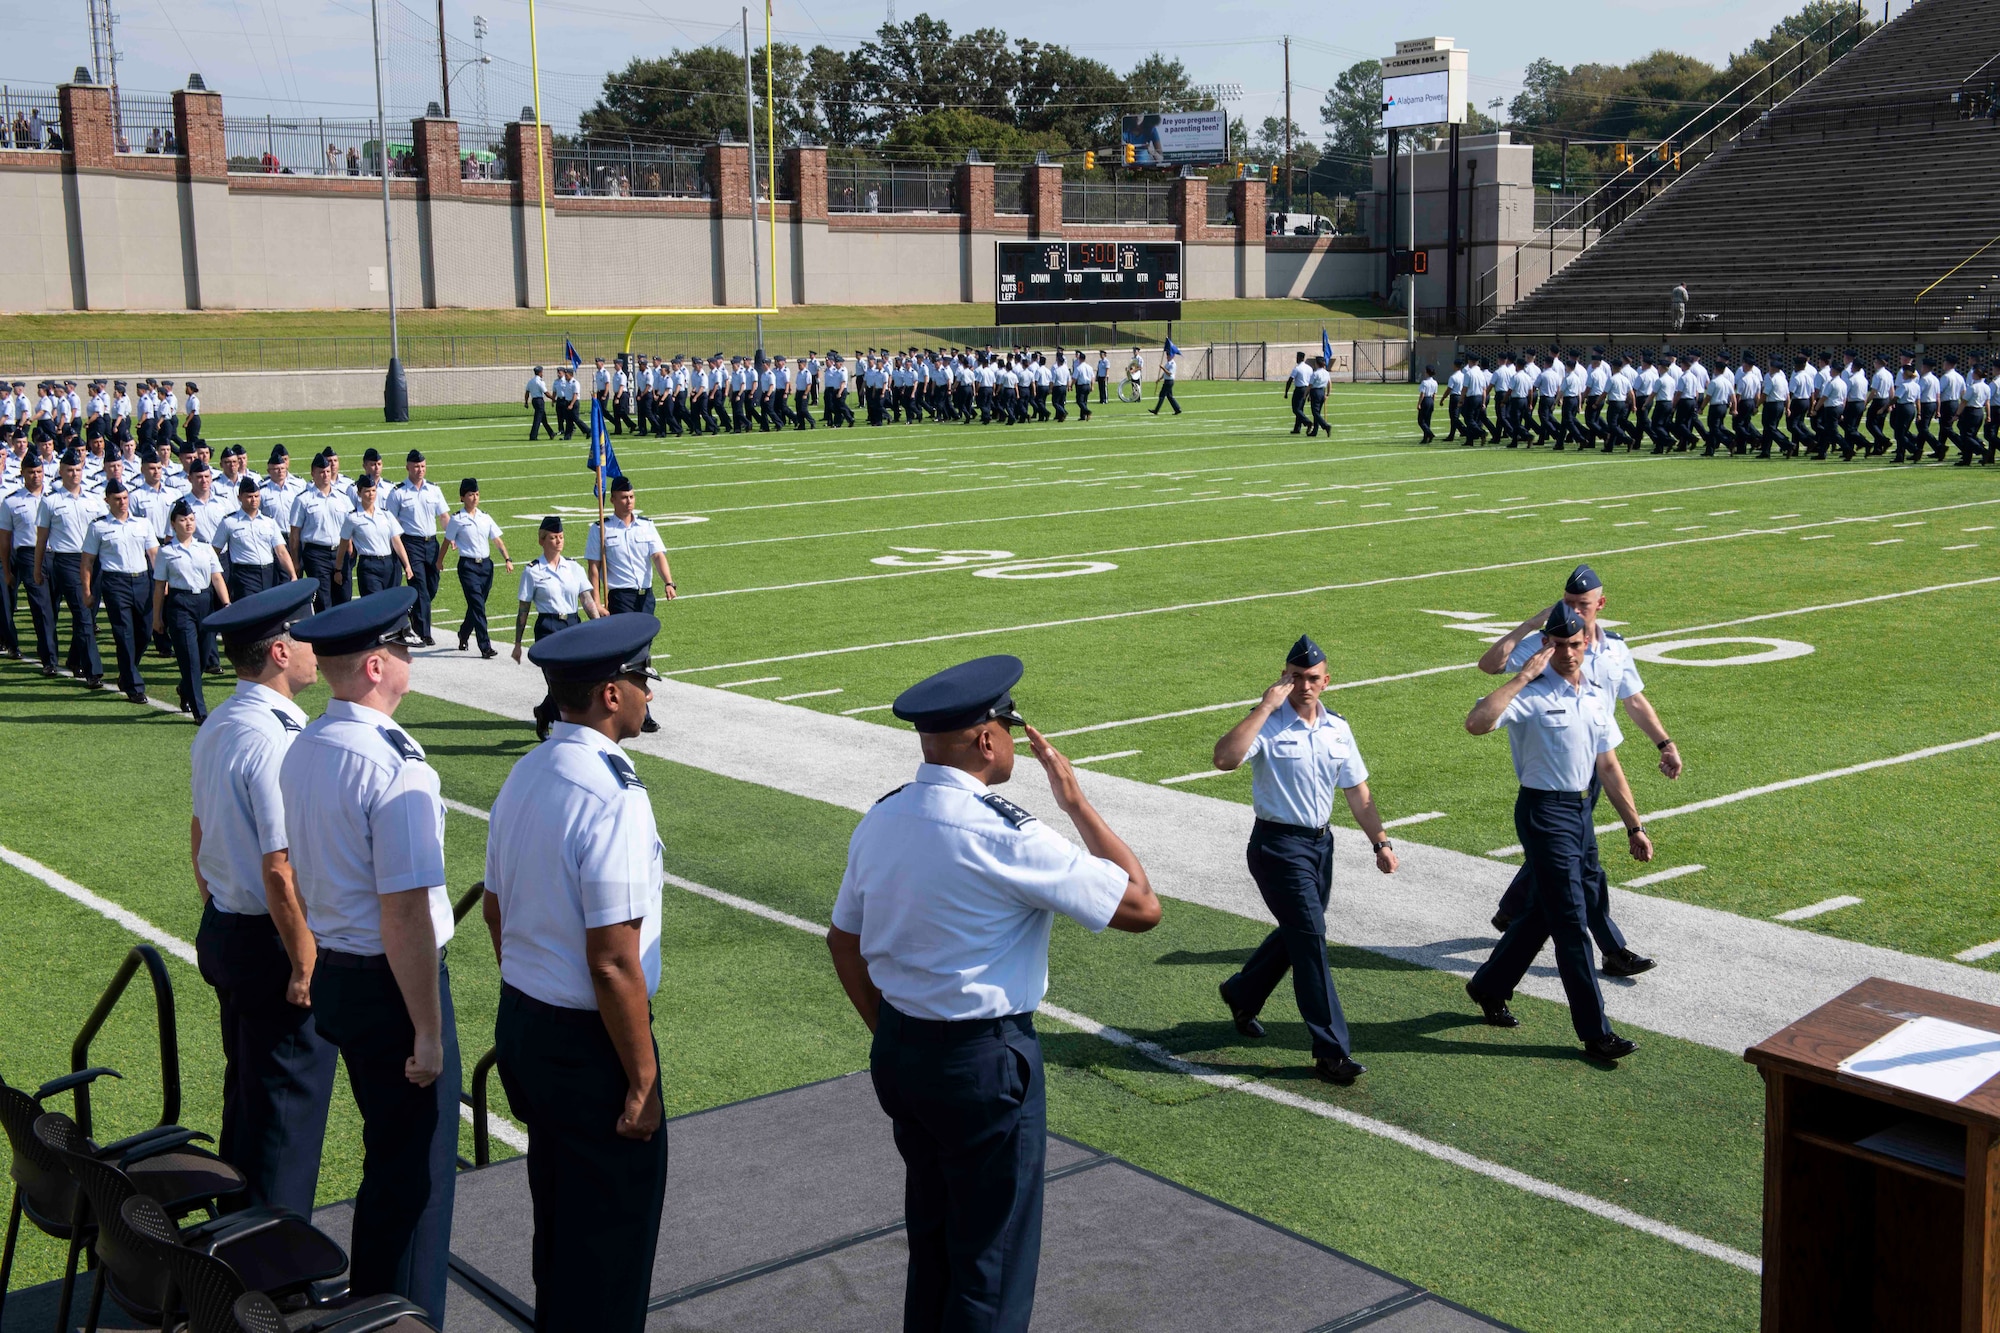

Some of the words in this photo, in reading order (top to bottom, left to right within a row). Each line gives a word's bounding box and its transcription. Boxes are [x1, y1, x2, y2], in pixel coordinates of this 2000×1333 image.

[1393, 58, 1420, 67] CRAMTON
[1421, 56, 1438, 64] BOWL
[1397, 96, 1424, 105] Alabama
[1425, 93, 1444, 102] Power
[1174, 118, 1186, 126] you
[1187, 116, 1216, 125] pregnant
[1170, 125, 1201, 134] parenting
[1080, 243, 1116, 263] 5:00
[1414, 251, 1427, 273] 0
[1002, 274, 1016, 283] TIME
[1030, 273, 1051, 284] DOWN
[1064, 273, 1072, 283] TO
[1073, 273, 1083, 283] GO
[1101, 273, 1115, 283] BALL
[1115, 273, 1124, 283] ON
[1137, 273, 1149, 283] QTR
[1165, 273, 1178, 282] TIME
[1001, 283, 1017, 293] OUTS
[1017, 282, 1024, 294] 0
[1158, 280, 1164, 292] 0
[1164, 282, 1179, 291] OUTS
[1001, 293, 1016, 301] LEFT
[1165, 291, 1178, 299] LEFT
[627, 355, 635, 414] CRAMTON
